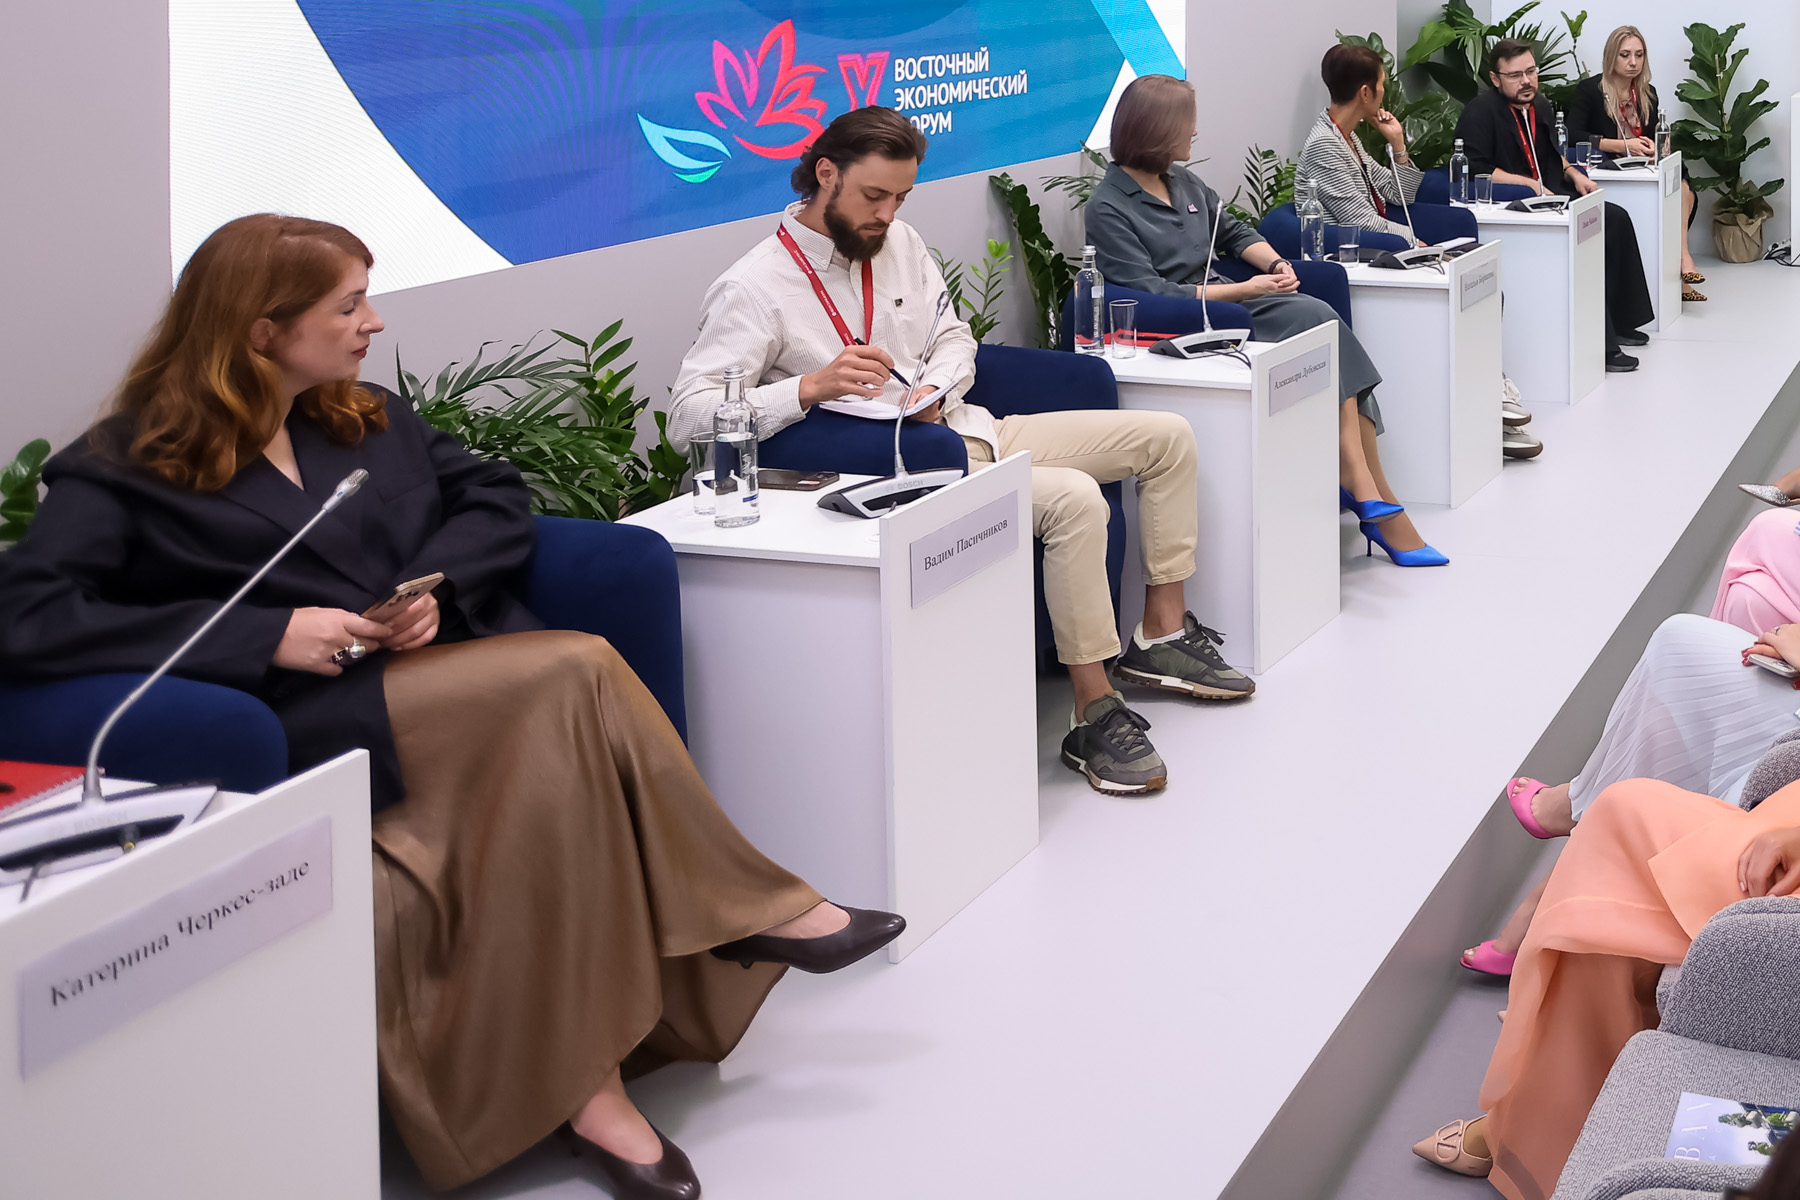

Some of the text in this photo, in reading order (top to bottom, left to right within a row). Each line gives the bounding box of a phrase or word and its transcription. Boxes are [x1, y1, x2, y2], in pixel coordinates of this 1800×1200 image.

[894, 46, 989, 83] ВОСТОЧНЫЙ
[894, 69, 1029, 112] ЭКОНОМИЧЕСКИЙ
[908, 111, 952, 135] ОРУМ
[897, 480, 924, 490] BOSCH
[924, 519, 1008, 571] Вадим Пасичников
[50, 862, 310, 1007] Катерина Черкес-заде
